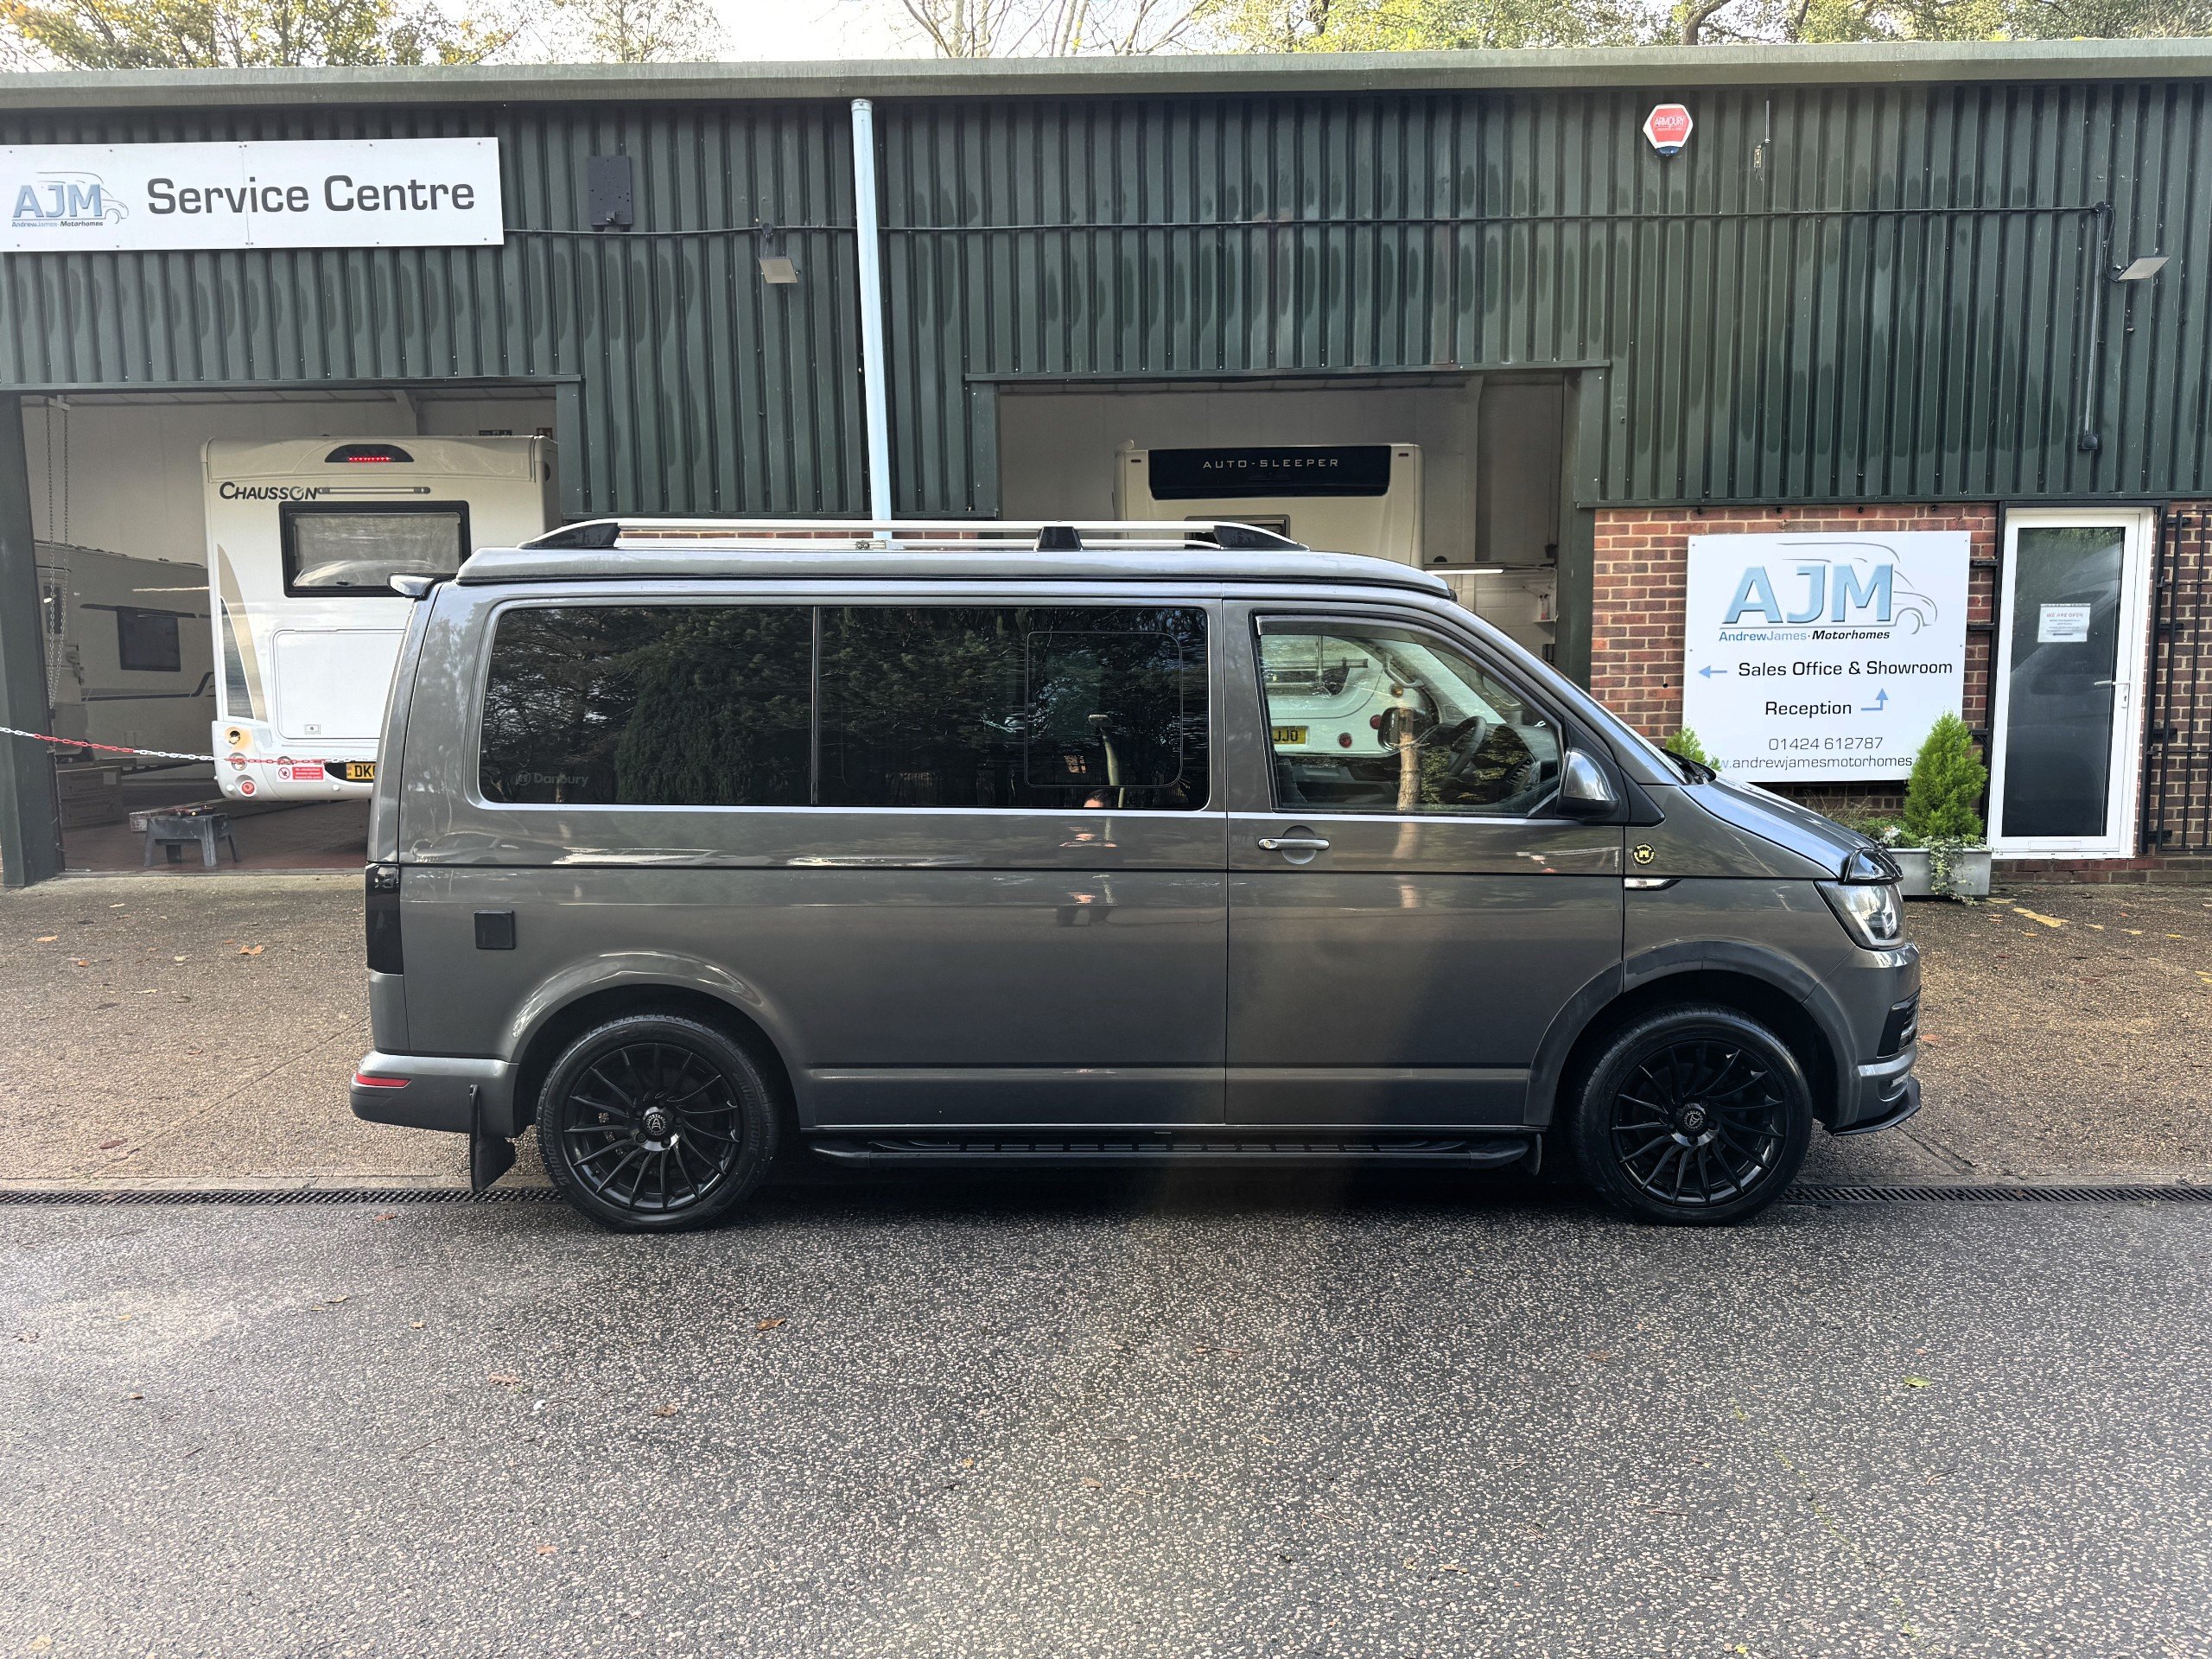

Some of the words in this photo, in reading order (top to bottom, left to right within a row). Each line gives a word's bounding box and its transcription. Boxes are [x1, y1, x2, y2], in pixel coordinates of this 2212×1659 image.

[12, 183, 103, 218] AJM
[147, 176, 309, 214] Service
[323, 174, 475, 212] Centre
[219, 480, 318, 501] CHAUSSON
[1721, 563, 1893, 625] AJM
[1738, 661, 1787, 677] Sales
[1792, 661, 1842, 676] Office
[1847, 660, 1861, 675] &
[1866, 660, 1953, 675] Showroom
[1764, 701, 1853, 718] Reception
[1768, 737, 1820, 751] 01424
[1824, 736, 1884, 750] 612787
[1720, 754, 1920, 771] w.andrewjamesmotorhomes
[533, 772, 588, 787] Danbury
